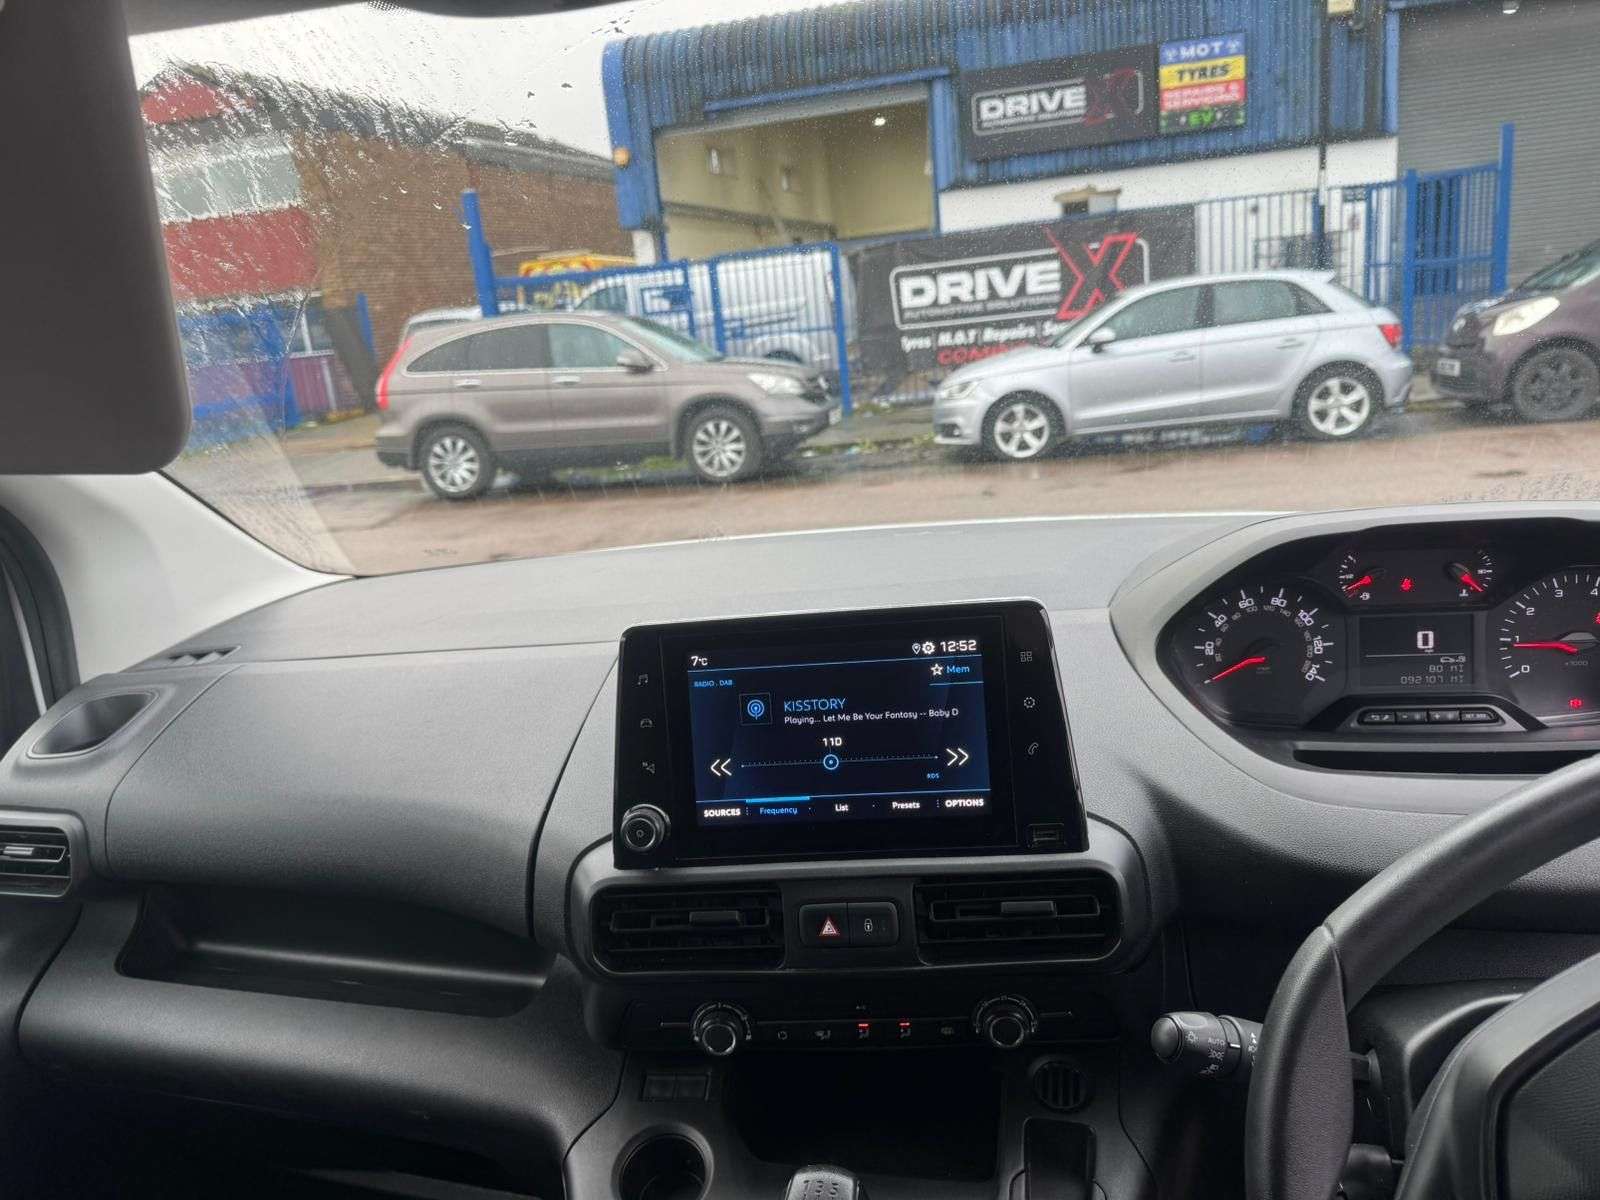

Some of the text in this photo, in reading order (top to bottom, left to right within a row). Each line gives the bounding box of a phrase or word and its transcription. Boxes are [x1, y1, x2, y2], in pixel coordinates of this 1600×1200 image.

[1180, 42, 1224, 58] MOT
[1175, 64, 1232, 82] TYRES
[979, 85, 1087, 122] DRIVE
[899, 260, 1062, 309] DRIVE
[1554, 589, 1564, 598] 3
[1238, 598, 1255, 609] 60
[1270, 597, 1287, 608] 80
[1525, 607, 1536, 616] 2
[1214, 614, 1228, 628] 40
[1298, 609, 1315, 626] 100
[1312, 635, 1324, 655] 120
[1416, 630, 1435, 649] 0
[940, 640, 977, 652] 12:52
[1204, 641, 1215, 656] 20
[946, 664, 971, 674] Mem
[1305, 663, 1320, 681] 140
[1521, 664, 1531, 674] 0
[783, 698, 846, 712] KISSTORY
[823, 714, 836, 722] Let
[838, 713, 851, 722] Me
[853, 712, 863, 721] Be
[864, 711, 883, 721] Your
[885, 710, 918, 720] Fantasy
[929, 708, 950, 718] Baby
[952, 708, 959, 717] D
[822, 737, 842, 747] 11D
[835, 803, 849, 812] List
[892, 801, 920, 810] Presets
[945, 798, 985, 808] OPTIONS
[703, 807, 741, 817] SOURCES
[759, 806, 798, 816] Frequency
[1207, 1037, 1226, 1046] AUTO
